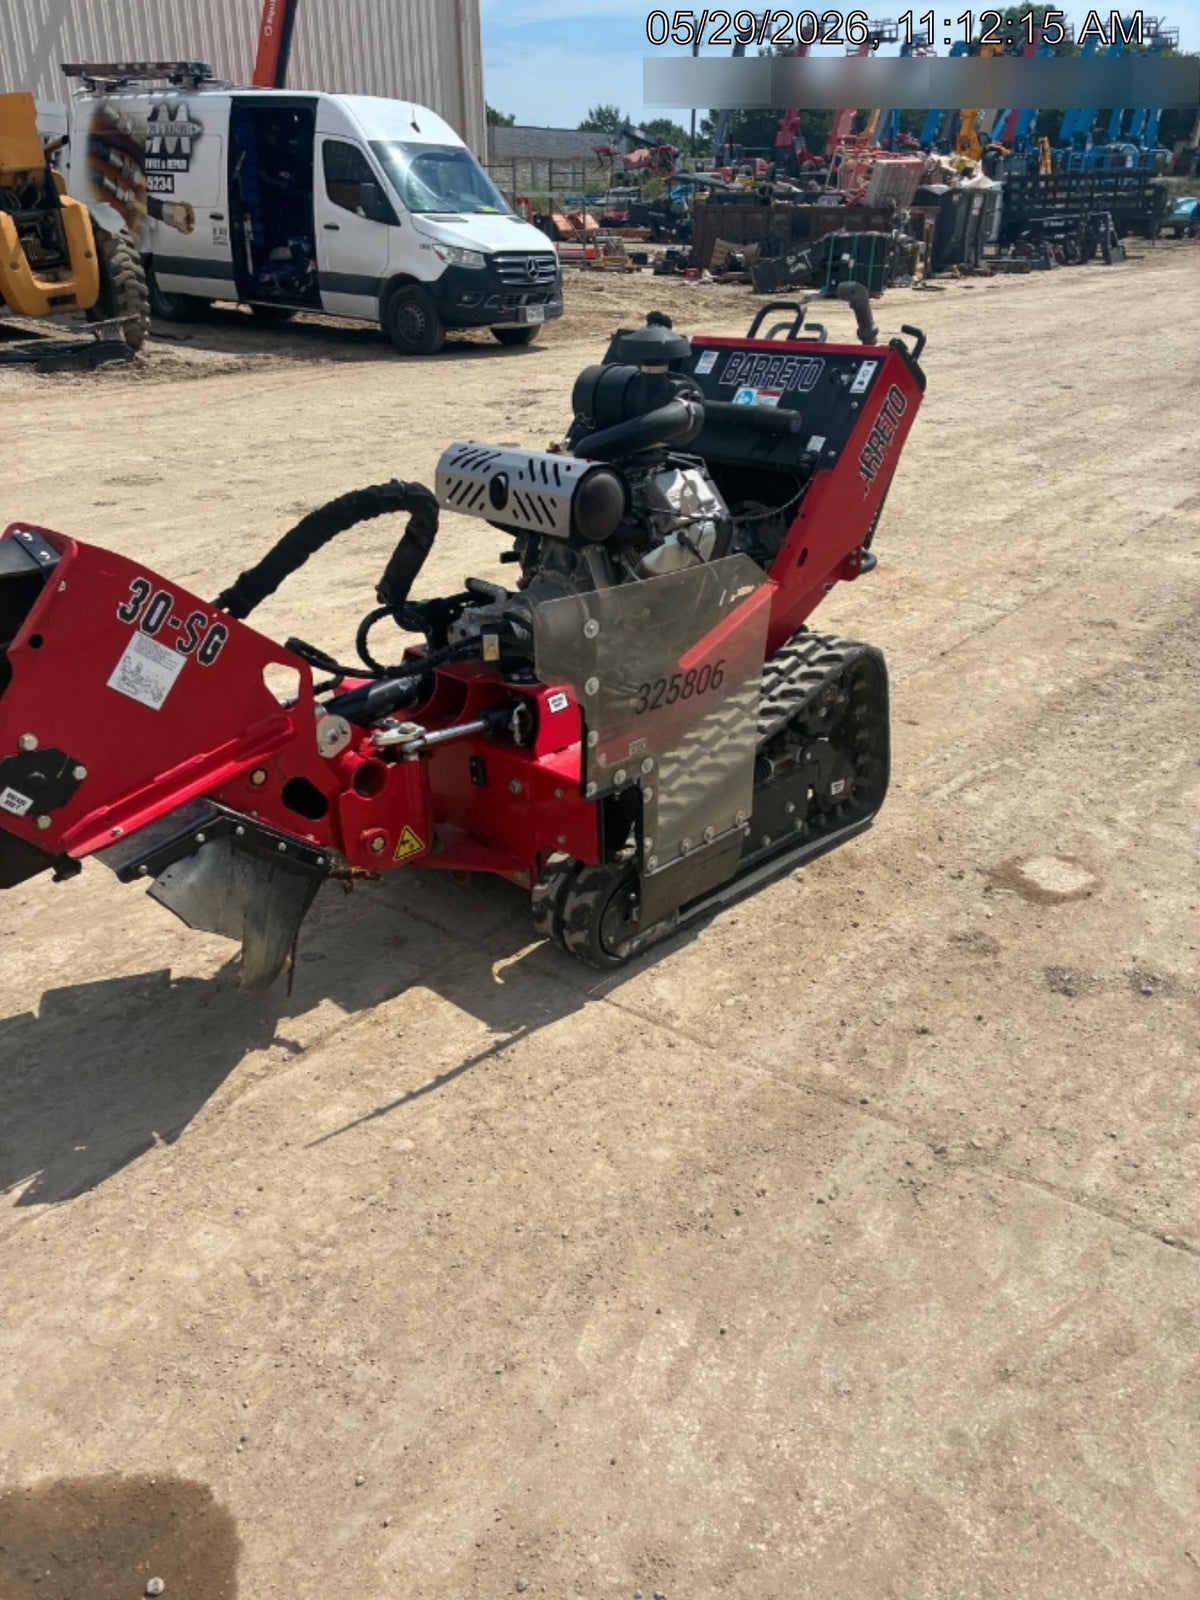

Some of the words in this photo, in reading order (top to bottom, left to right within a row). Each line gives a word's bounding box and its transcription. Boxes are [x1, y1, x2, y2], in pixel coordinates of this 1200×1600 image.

[166, 159, 187, 170] REPAIR
[718, 351, 826, 393] BARRETO
[116, 575, 229, 667] 30-SG
[634, 659, 726, 716] 325806
